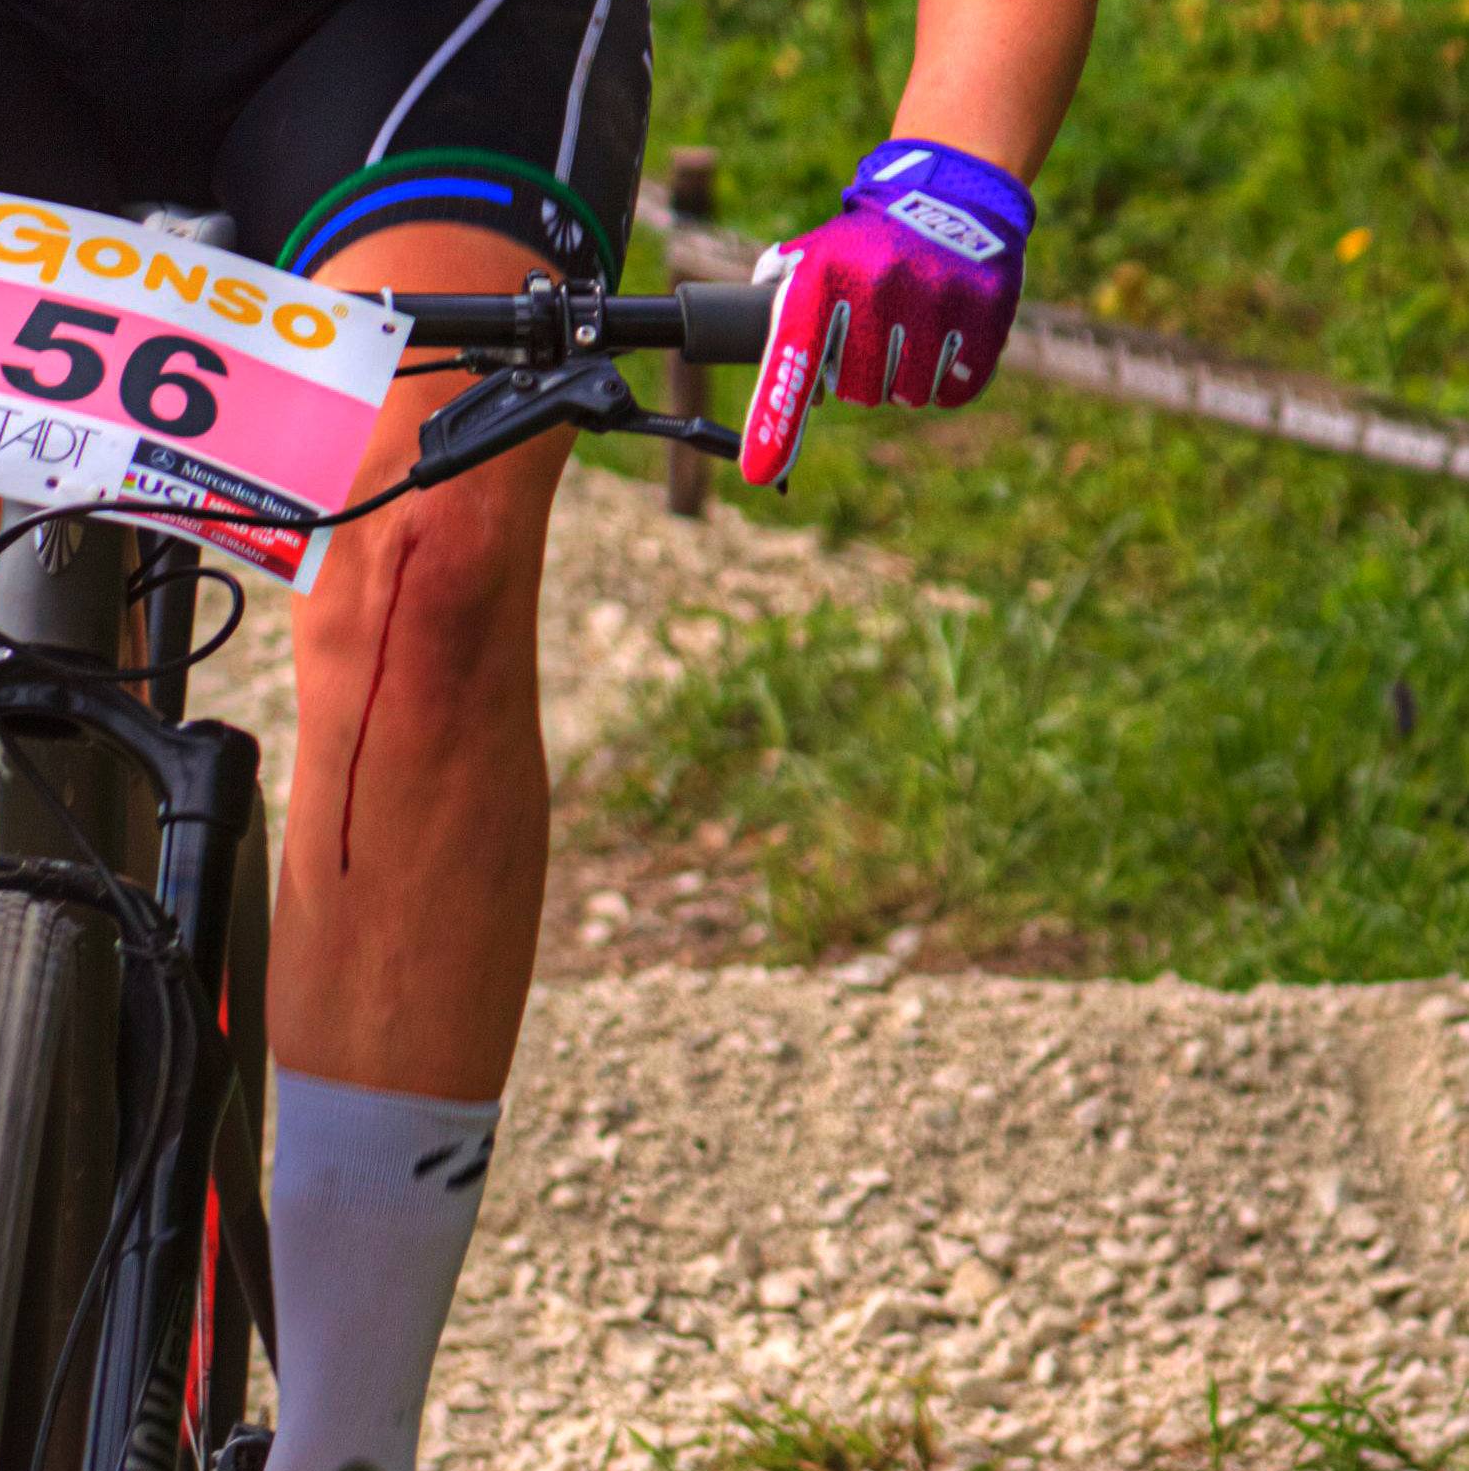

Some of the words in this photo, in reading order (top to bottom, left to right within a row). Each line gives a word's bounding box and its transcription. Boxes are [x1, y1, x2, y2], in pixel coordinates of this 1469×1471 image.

[0, 298, 230, 438] 56
[138, 473, 199, 509] UCI
[181, 459, 302, 521] Mercedes-Benz
